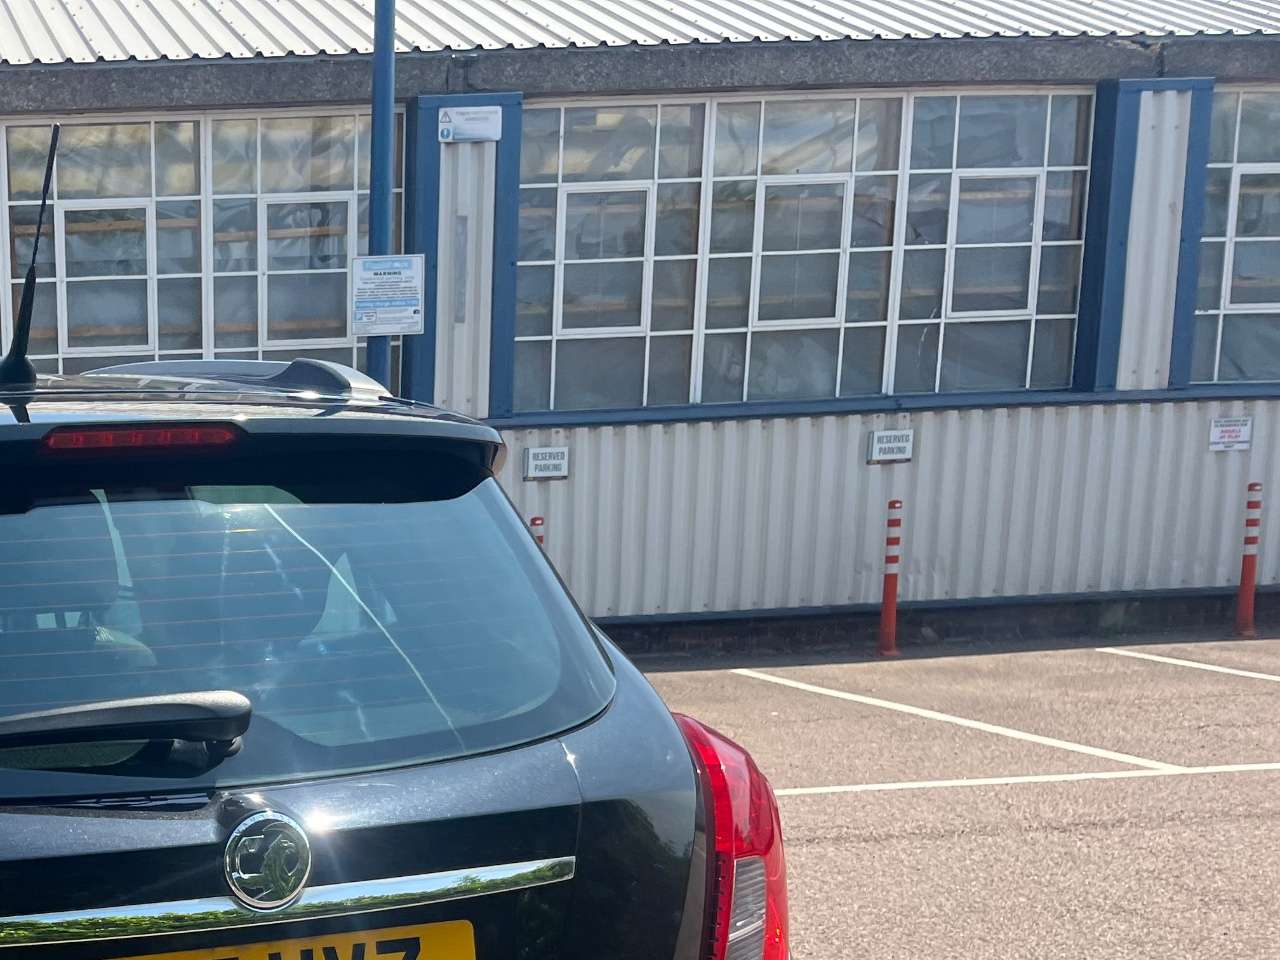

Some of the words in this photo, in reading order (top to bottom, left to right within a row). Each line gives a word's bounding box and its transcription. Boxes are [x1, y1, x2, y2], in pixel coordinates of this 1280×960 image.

[877, 434, 910, 444] RESERVED
[532, 451, 565, 461] RESERVED
[879, 446, 907, 456] PARKING
[534, 463, 562, 472] PARKING
